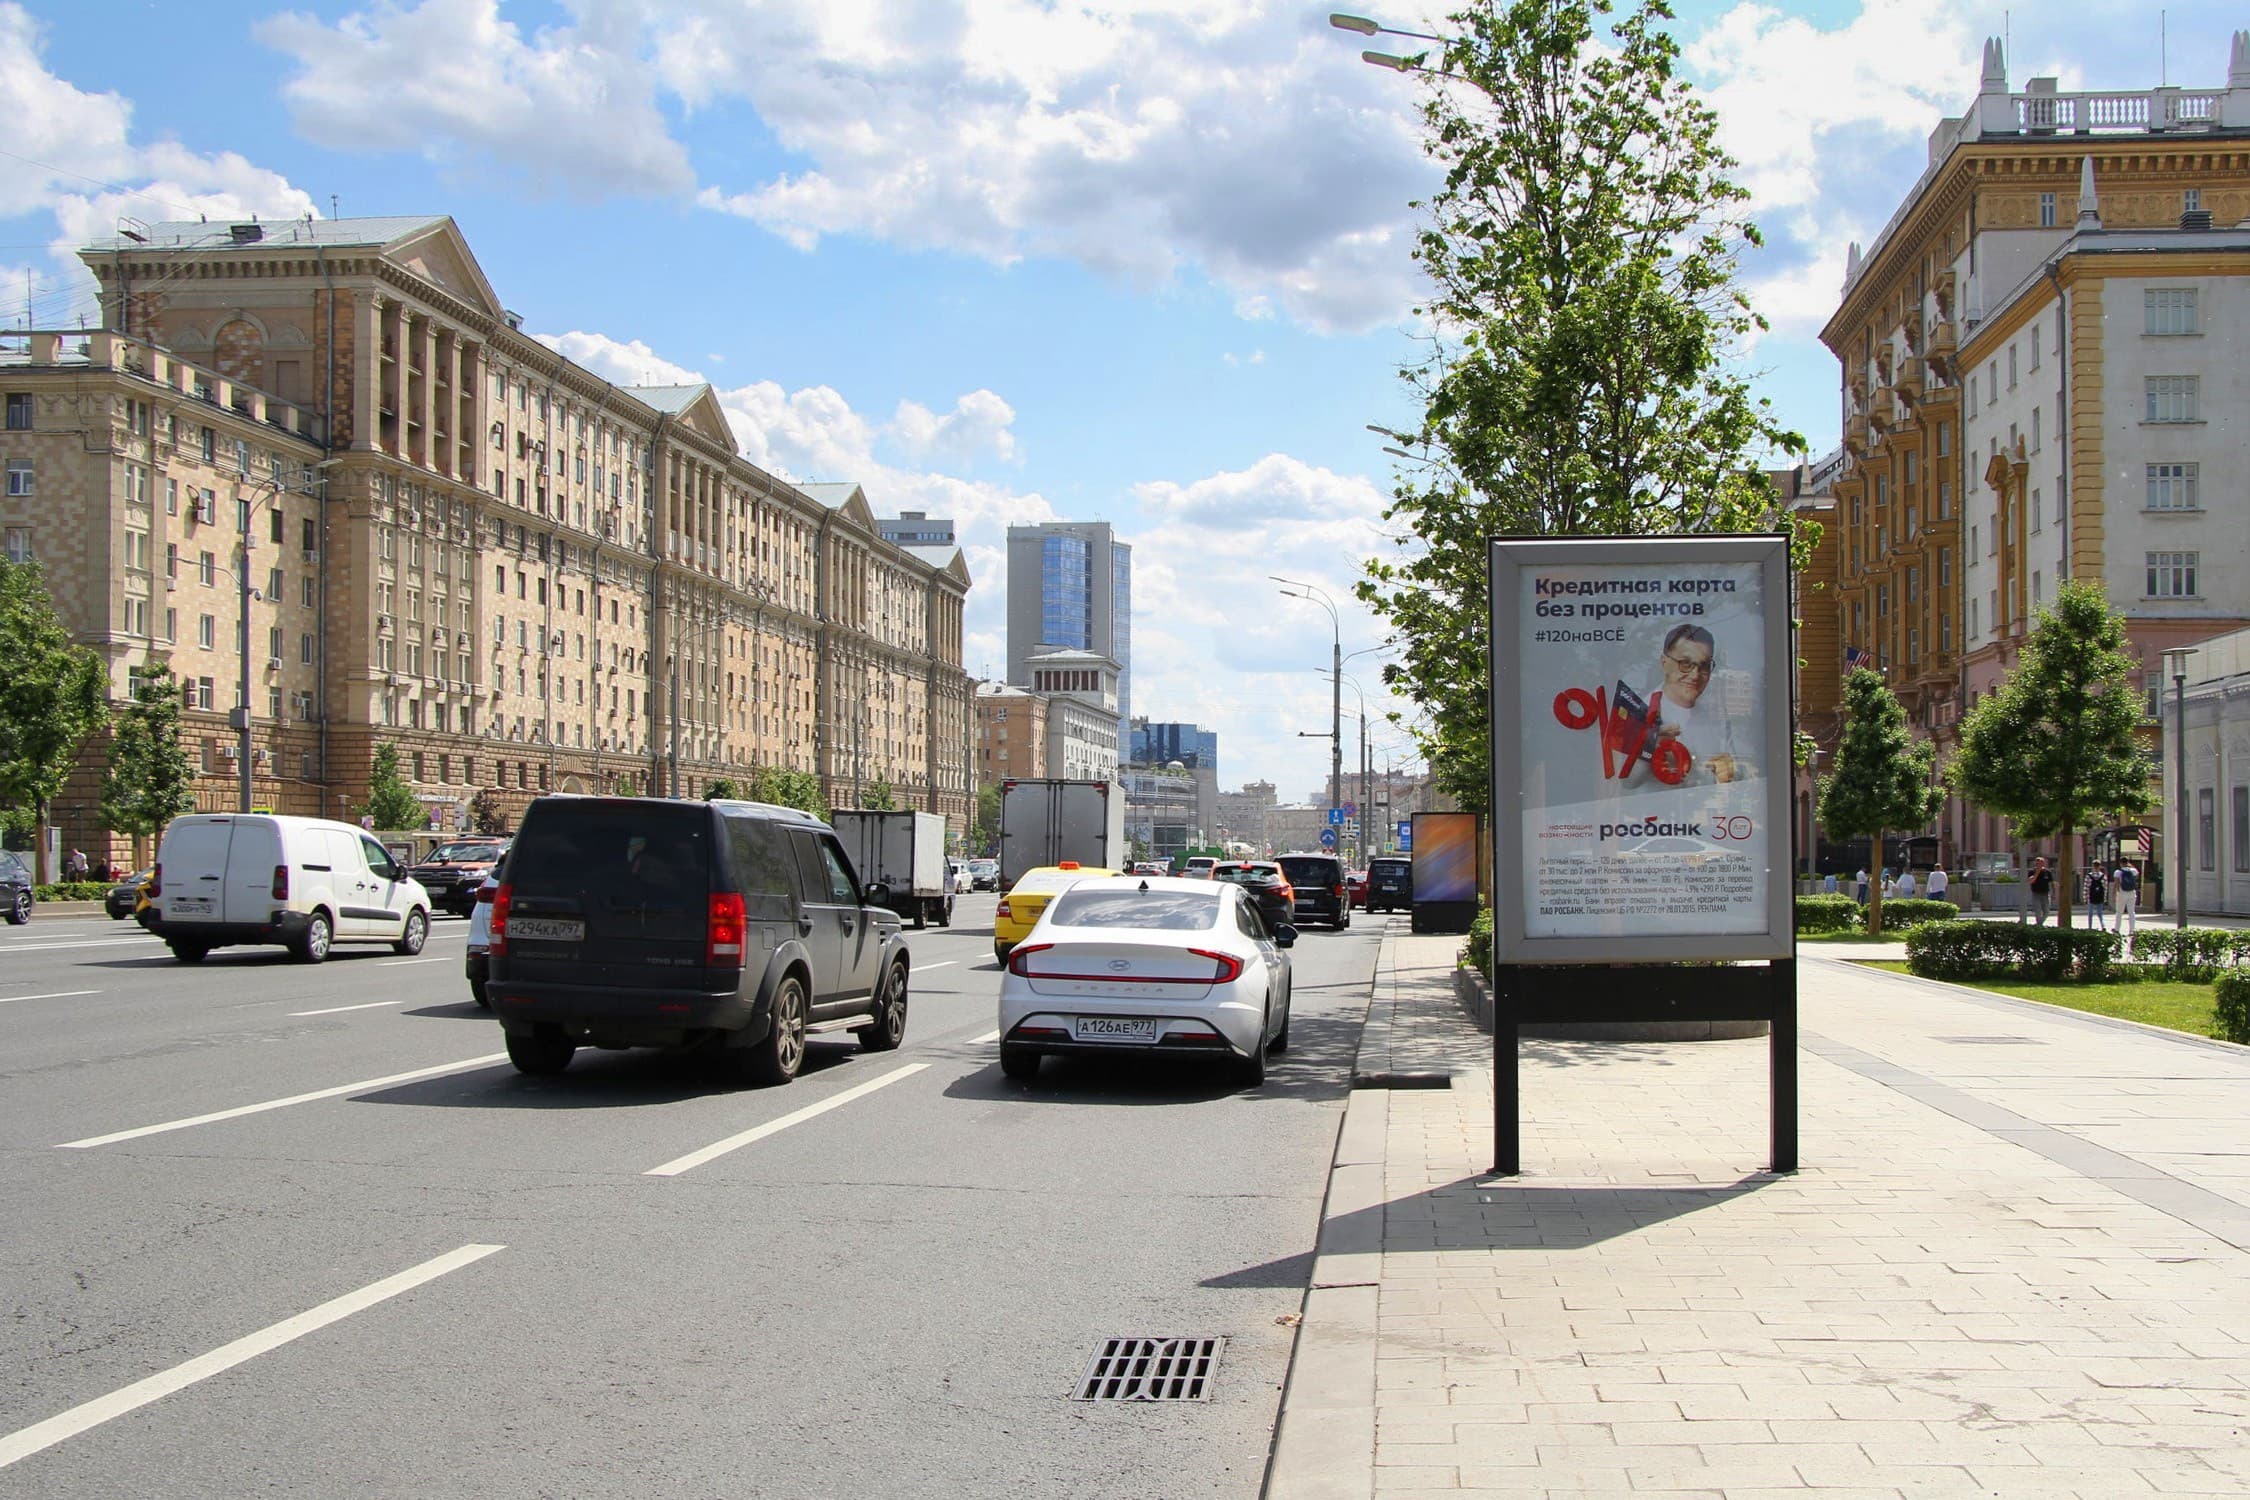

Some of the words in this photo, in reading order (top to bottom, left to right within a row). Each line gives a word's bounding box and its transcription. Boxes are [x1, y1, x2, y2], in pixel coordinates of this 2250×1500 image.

[1535, 577, 1662, 598] Кредитная
[1668, 579, 1736, 597] карта
[1535, 600, 1575, 618] без
[1581, 601, 1705, 620] процентов
[1535, 626, 1625, 642] #120наВСЁ
[1538, 831, 1594, 839] возможности
[1599, 816, 1703, 841] росбанк
[1711, 816, 1753, 841] 30
